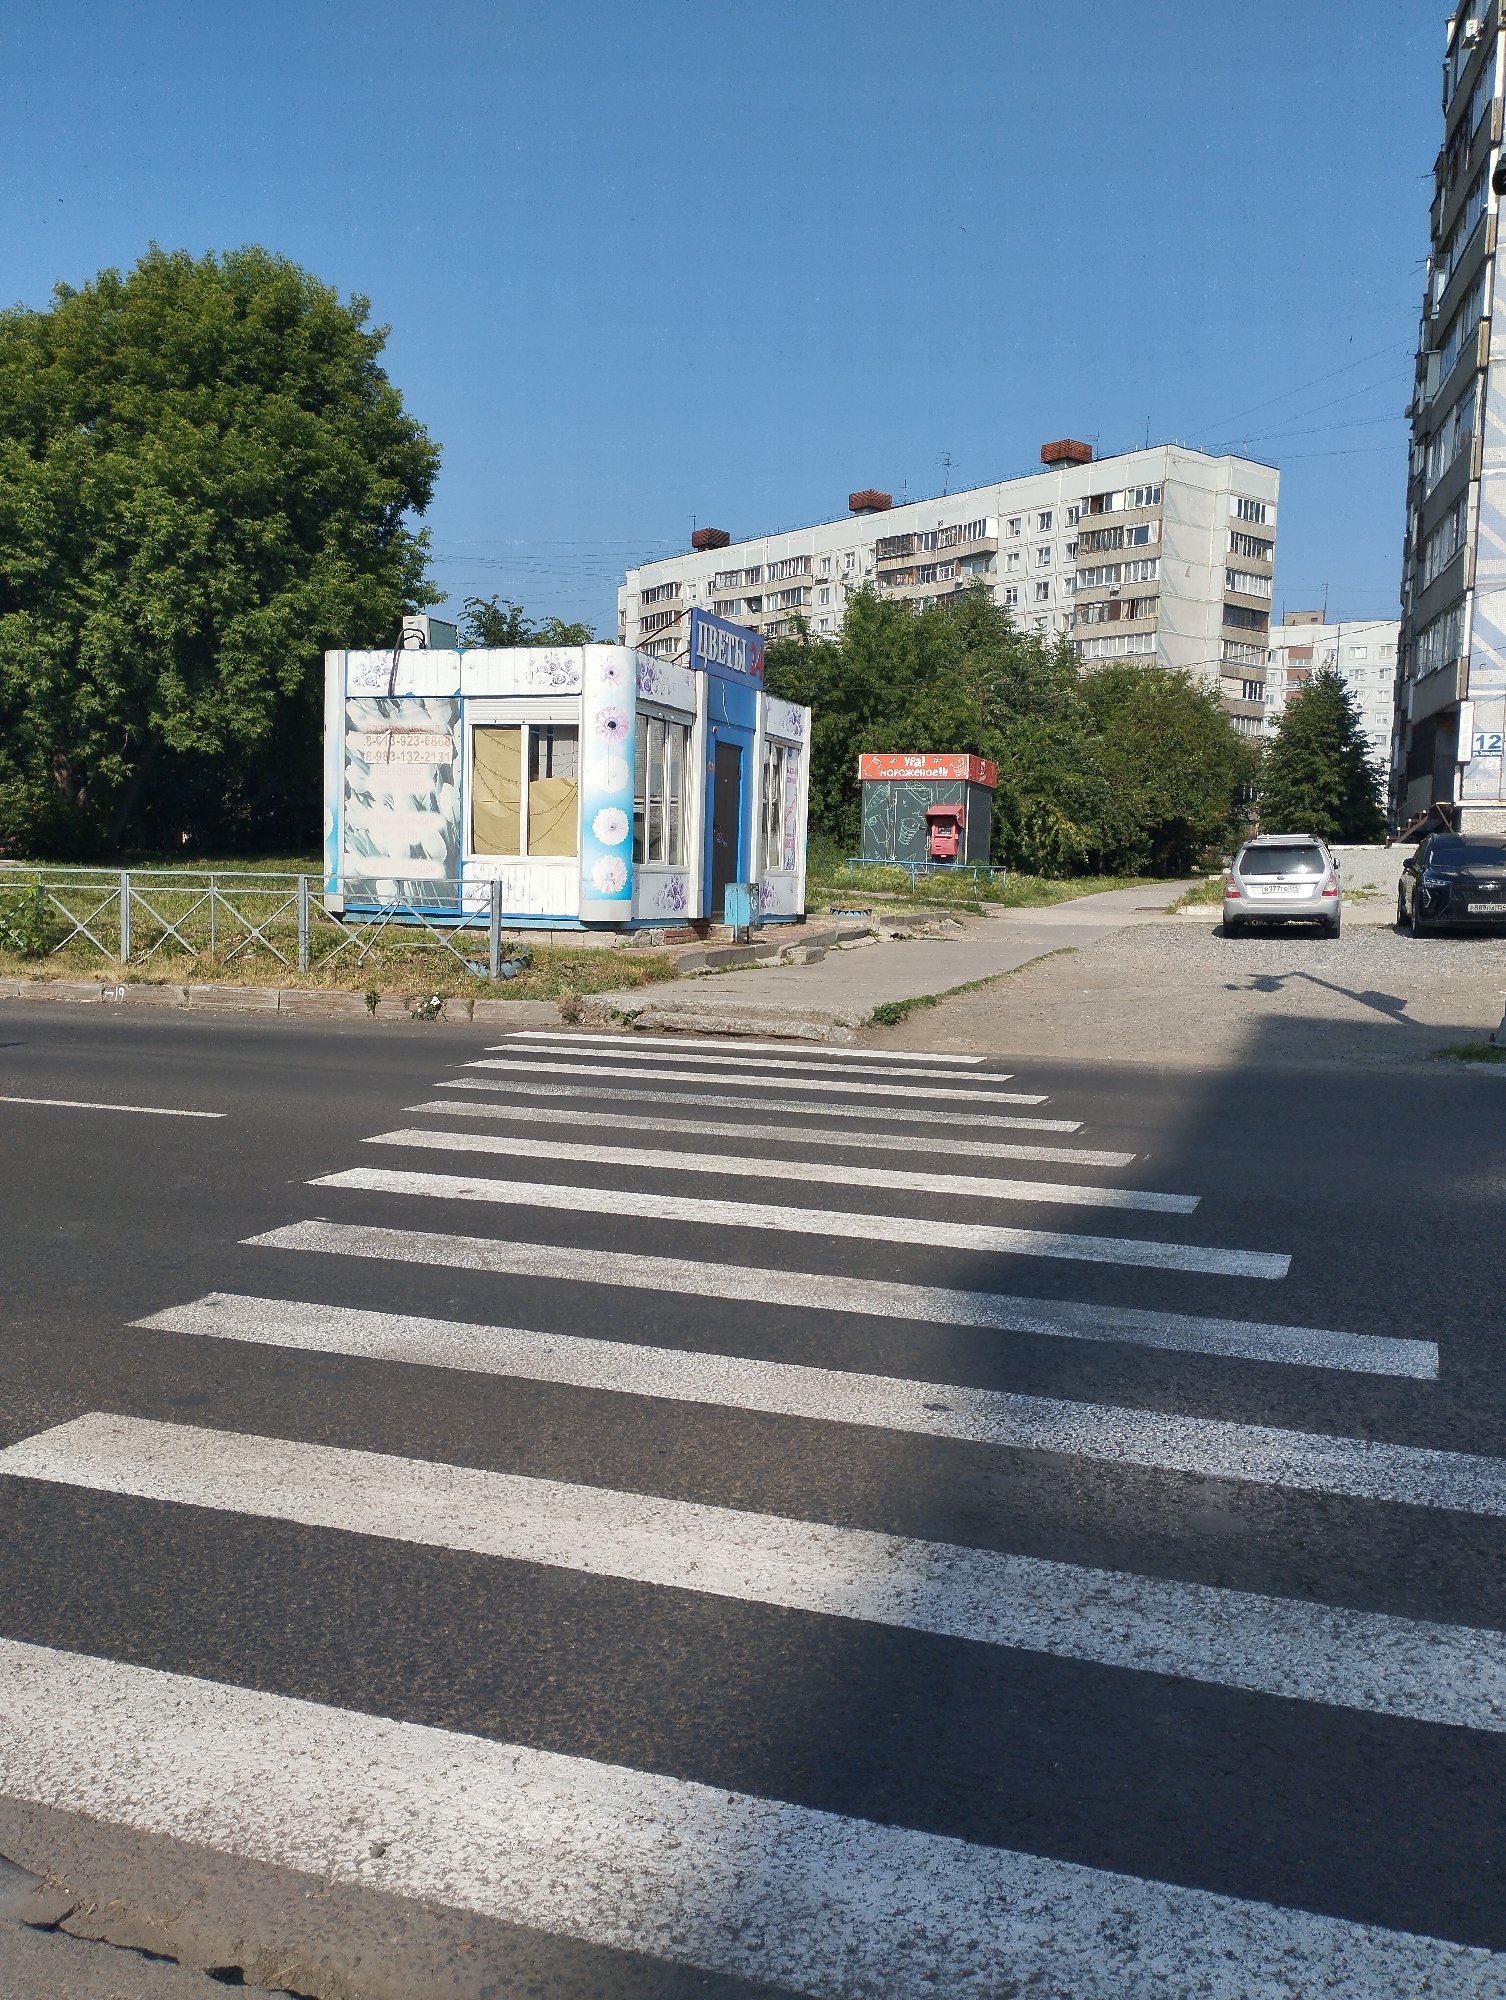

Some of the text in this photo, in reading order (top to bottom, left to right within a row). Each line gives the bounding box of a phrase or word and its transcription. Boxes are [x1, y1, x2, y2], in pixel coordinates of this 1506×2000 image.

[697, 620, 764, 678] ЦВЕТЫ 24
[366, 735, 451, 747] 8-913-923-6868
[1475, 735, 1501, 749] 12
[366, 750, 450, 762] 8-983-132-2131
